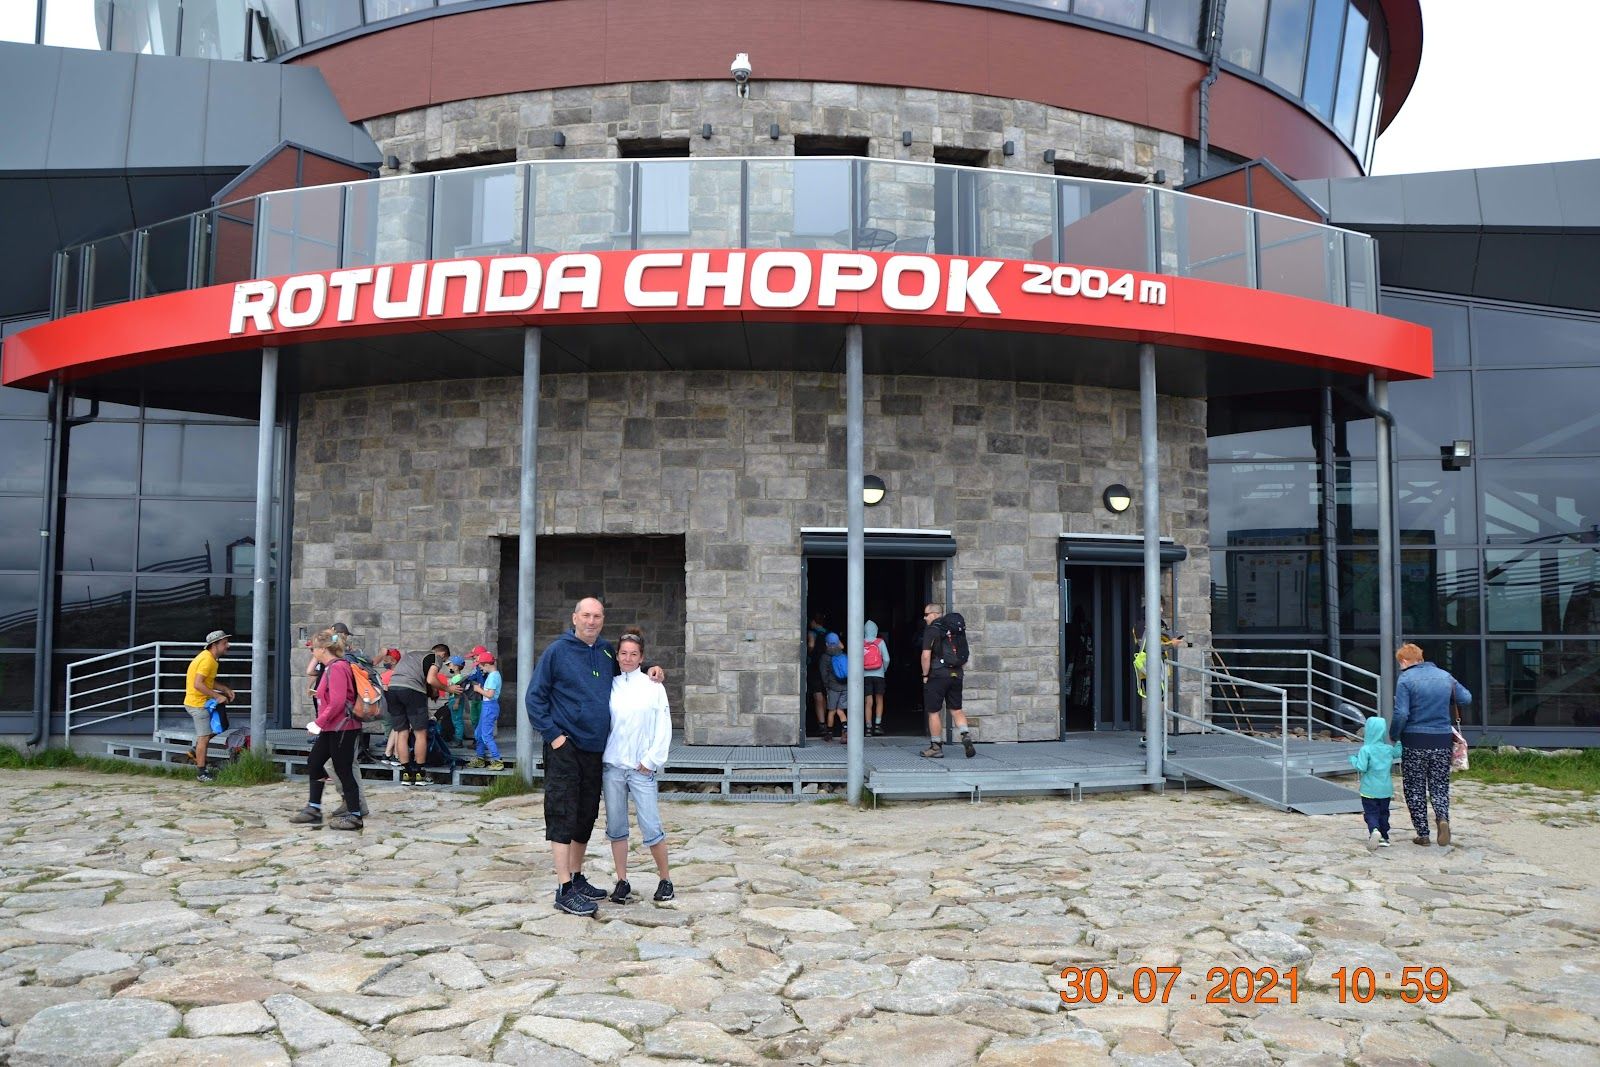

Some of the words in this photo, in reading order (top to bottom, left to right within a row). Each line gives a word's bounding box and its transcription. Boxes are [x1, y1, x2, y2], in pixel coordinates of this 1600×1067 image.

[229, 253, 602, 334] ROTUNDA
[623, 251, 1004, 314] CHOPOK
[1021, 263, 1134, 301] 2004
